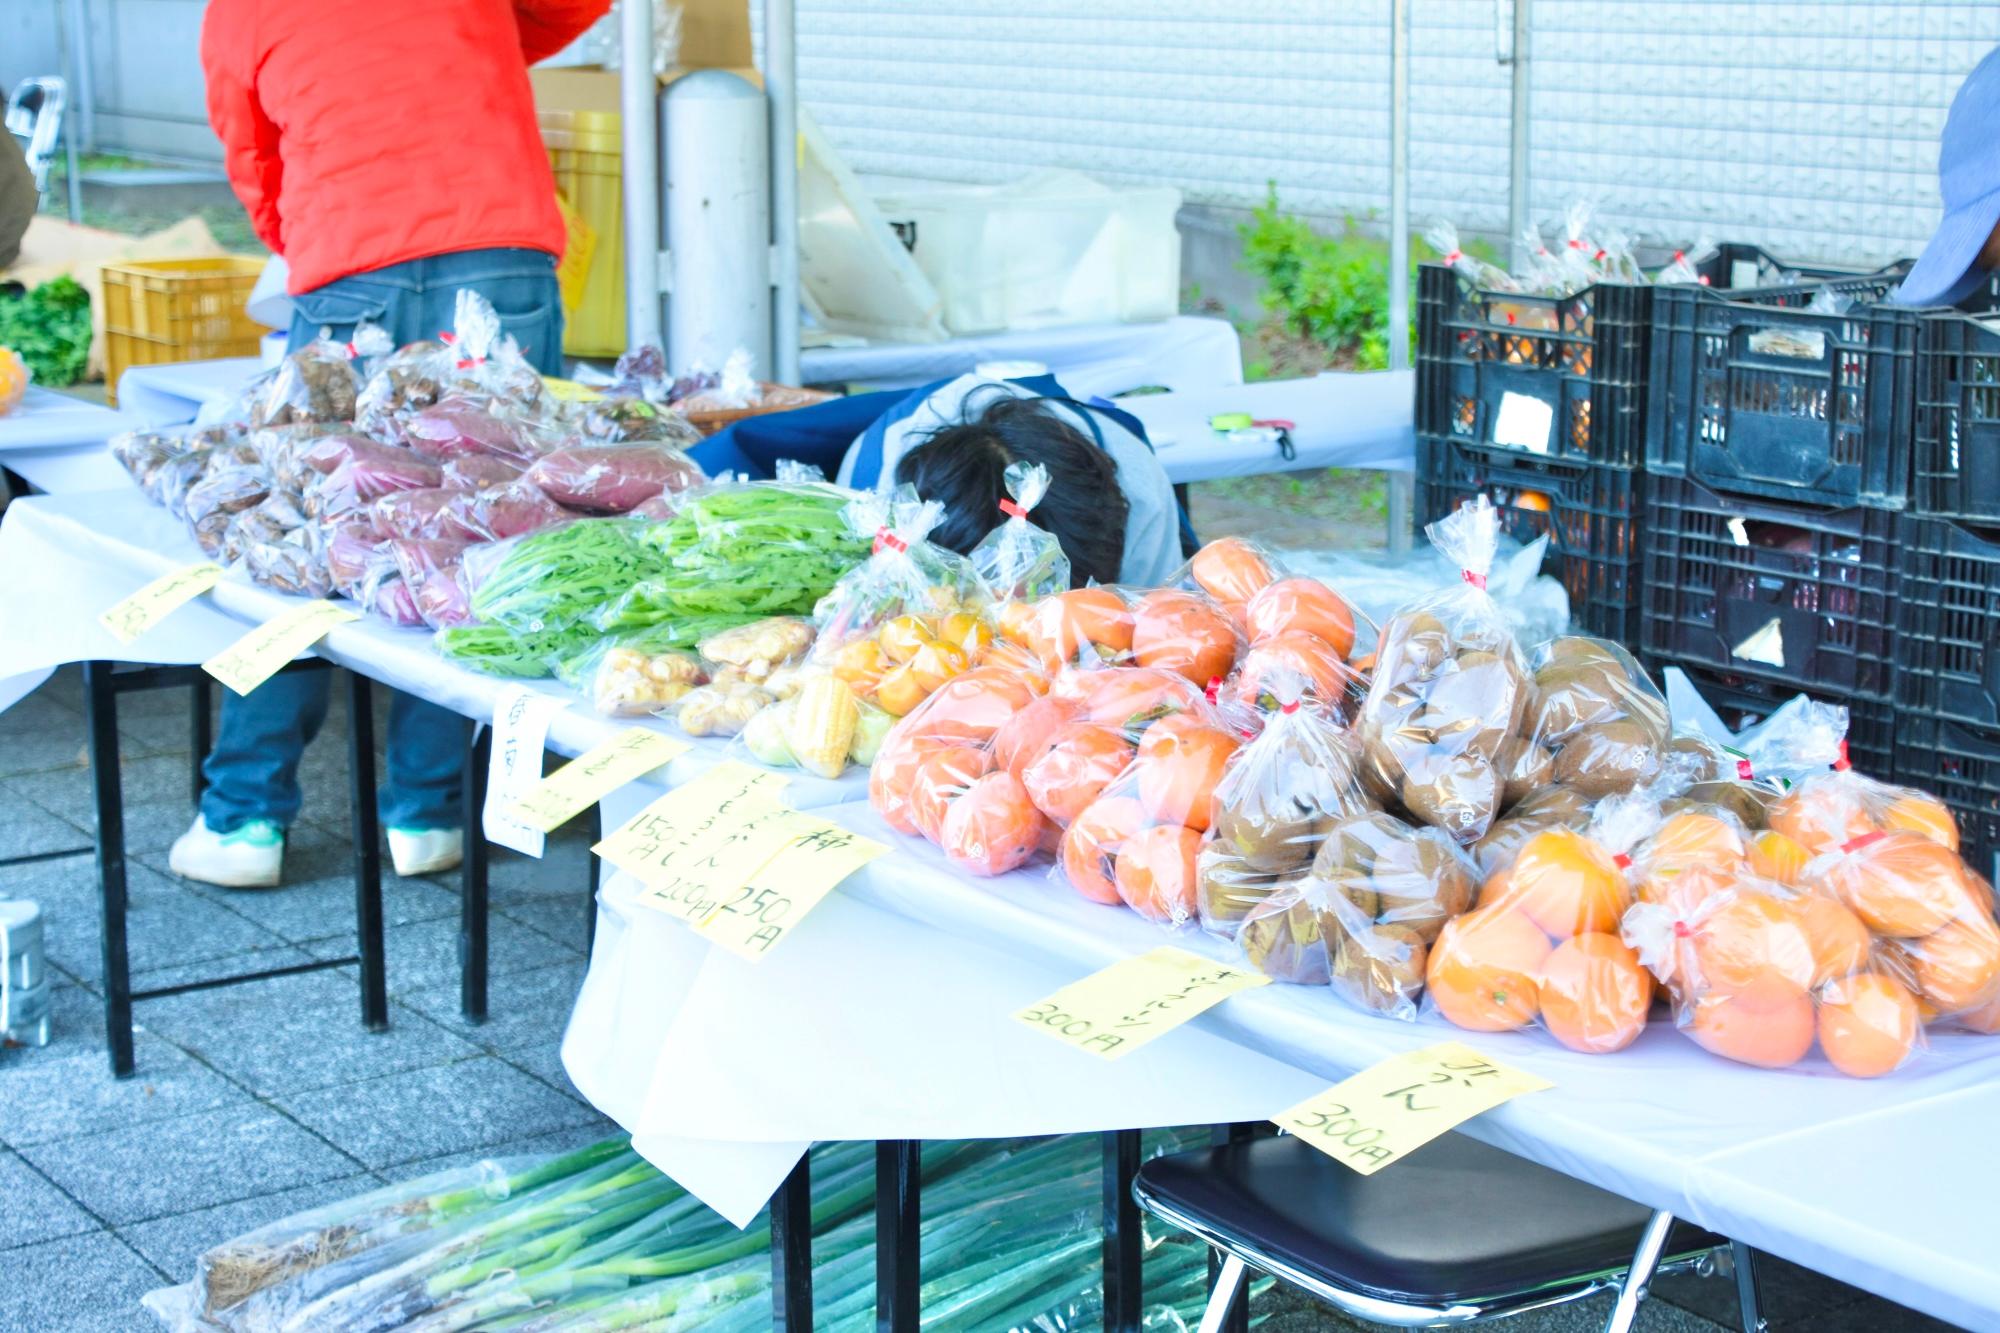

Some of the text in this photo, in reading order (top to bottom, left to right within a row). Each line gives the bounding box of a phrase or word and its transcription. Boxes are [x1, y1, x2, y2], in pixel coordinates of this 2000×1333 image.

[796, 829, 854, 853] 柿
[720, 886, 793, 952] 250円
[1022, 1003, 1126, 1053] 300円
[1382, 1057, 1501, 1113] みかん
[1293, 1102, 1394, 1167] 300円
